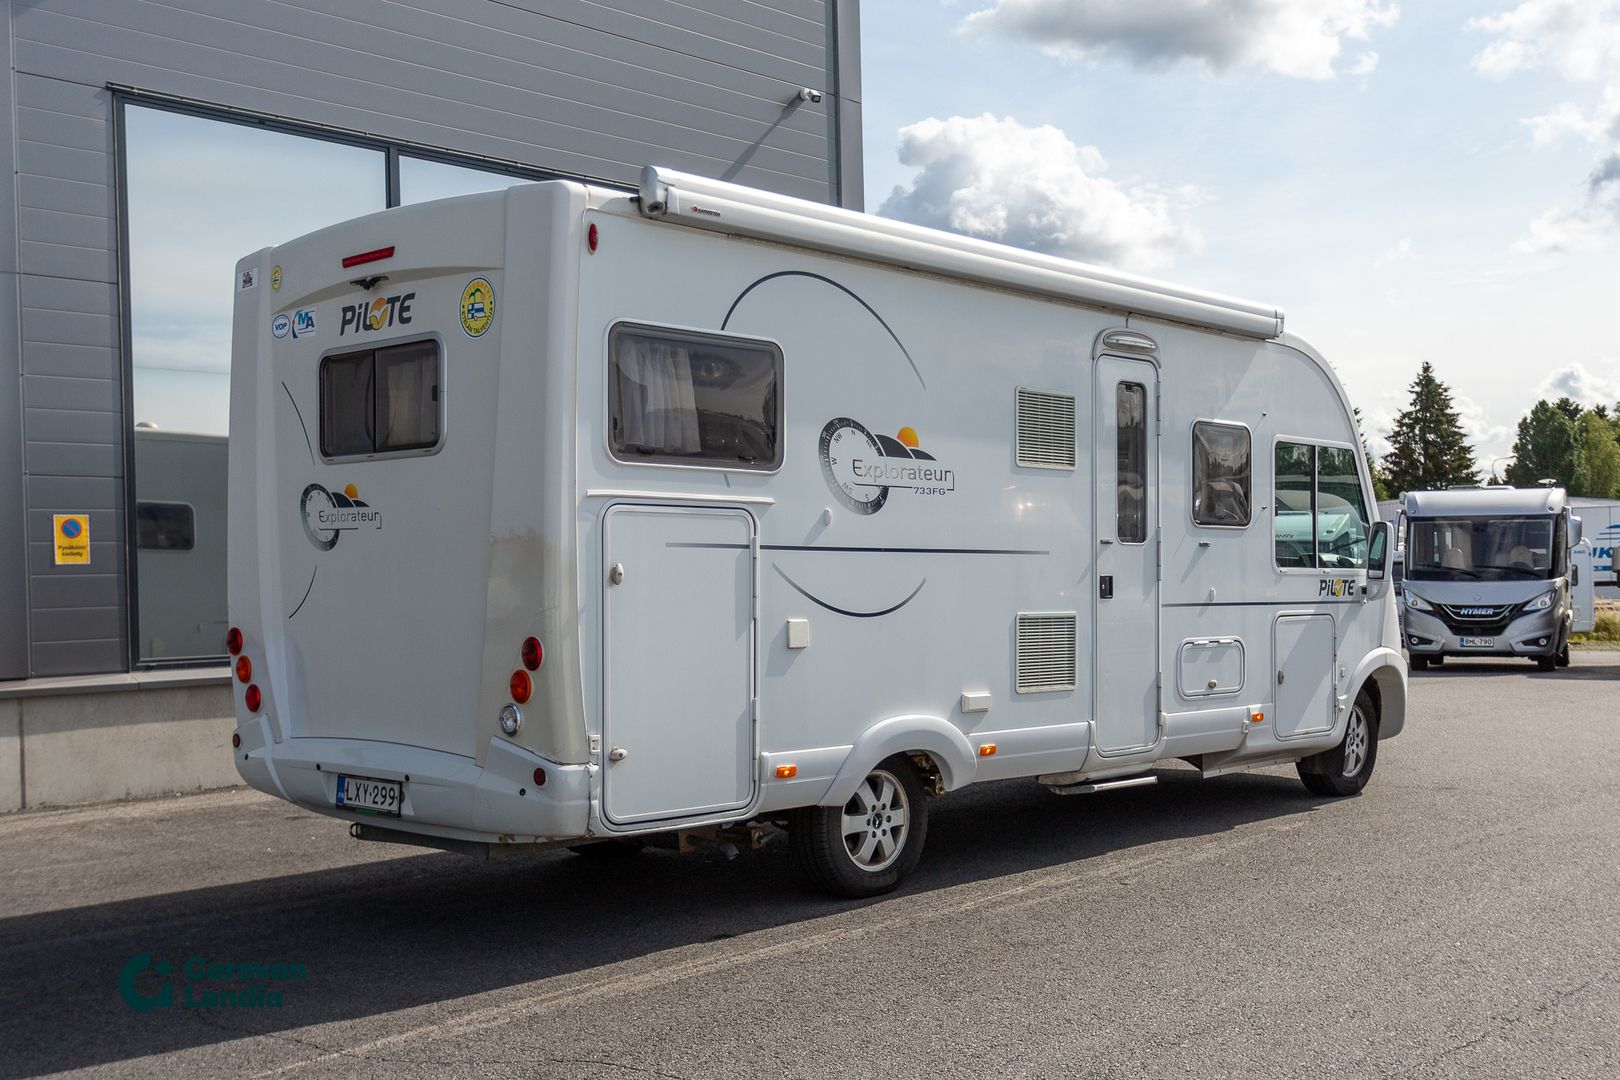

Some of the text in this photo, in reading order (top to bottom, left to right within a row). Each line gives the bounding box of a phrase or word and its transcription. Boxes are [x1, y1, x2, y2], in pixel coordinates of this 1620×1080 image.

[852, 458, 952, 483] Explorateur
[913, 486, 946, 496] 733FG
[318, 510, 381, 525] Explorateur
[345, 781, 397, 806] LXY-299
